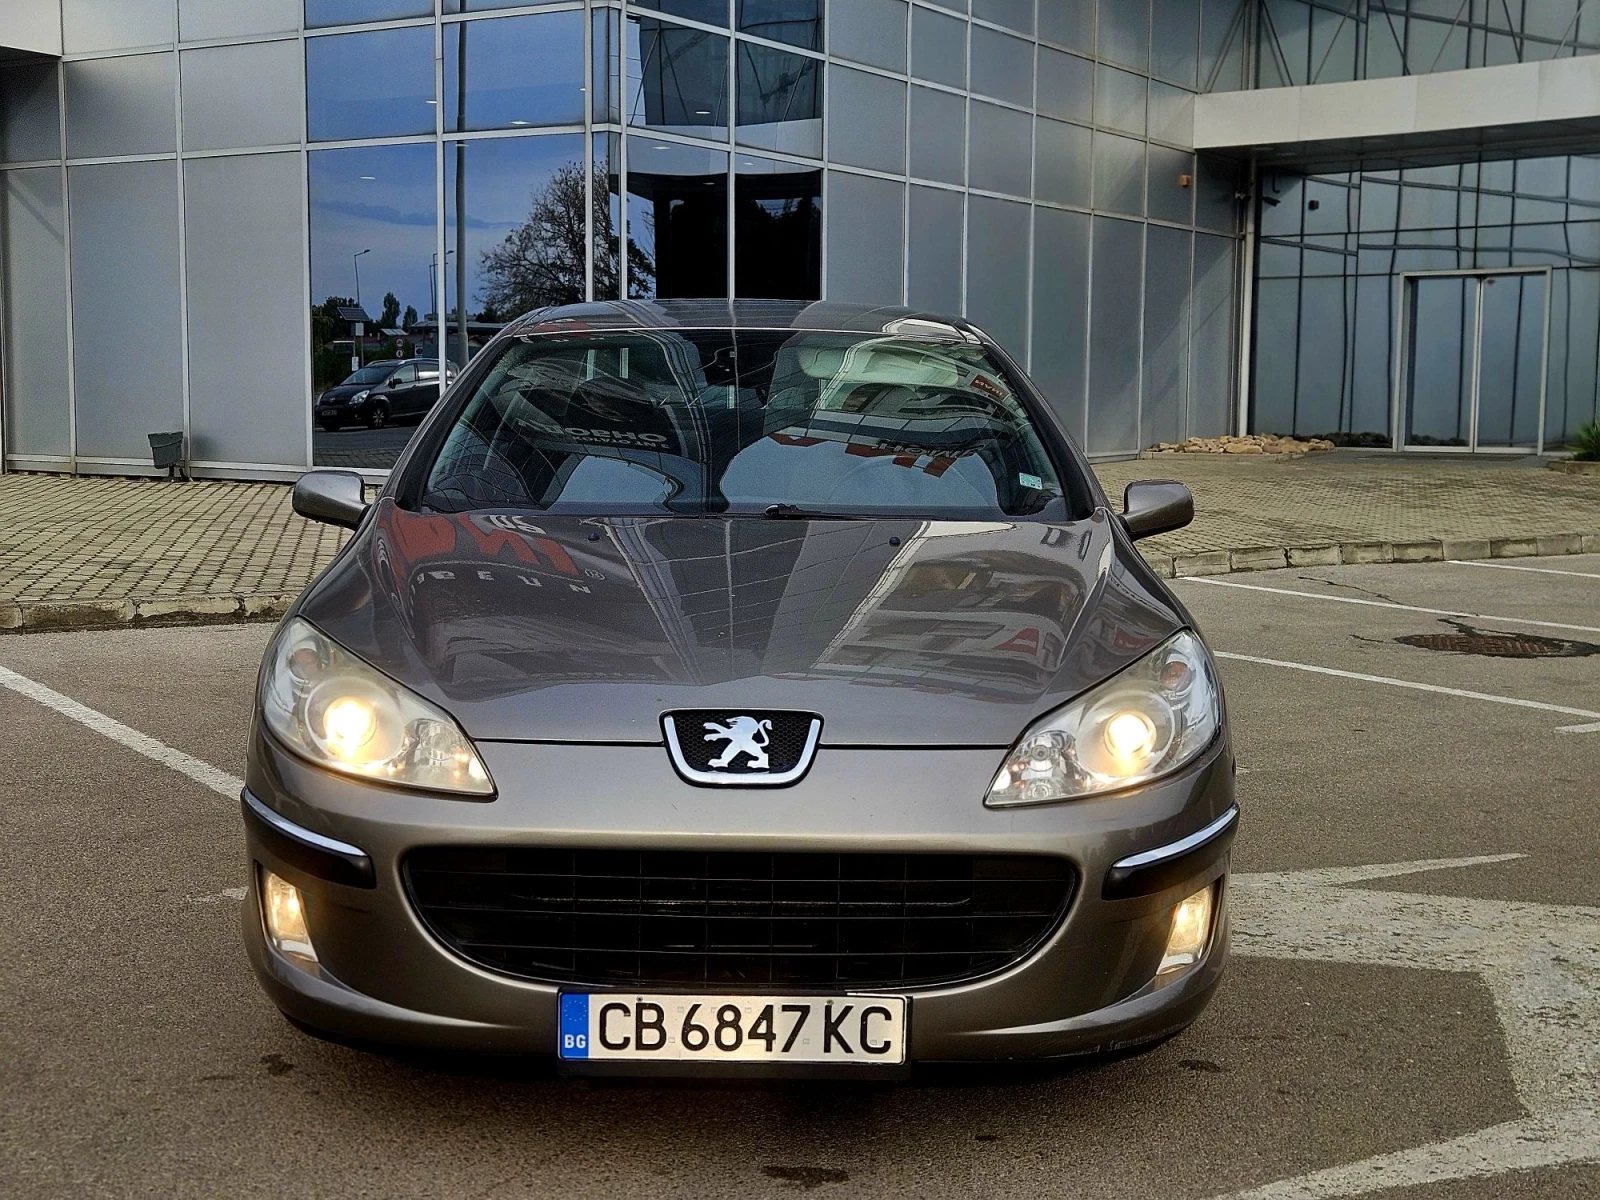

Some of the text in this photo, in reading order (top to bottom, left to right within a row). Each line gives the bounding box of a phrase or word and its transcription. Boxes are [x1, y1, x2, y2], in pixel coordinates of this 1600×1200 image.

[564, 1035, 587, 1049] BG
[599, 1002, 893, 1055] CB 6847 KC
